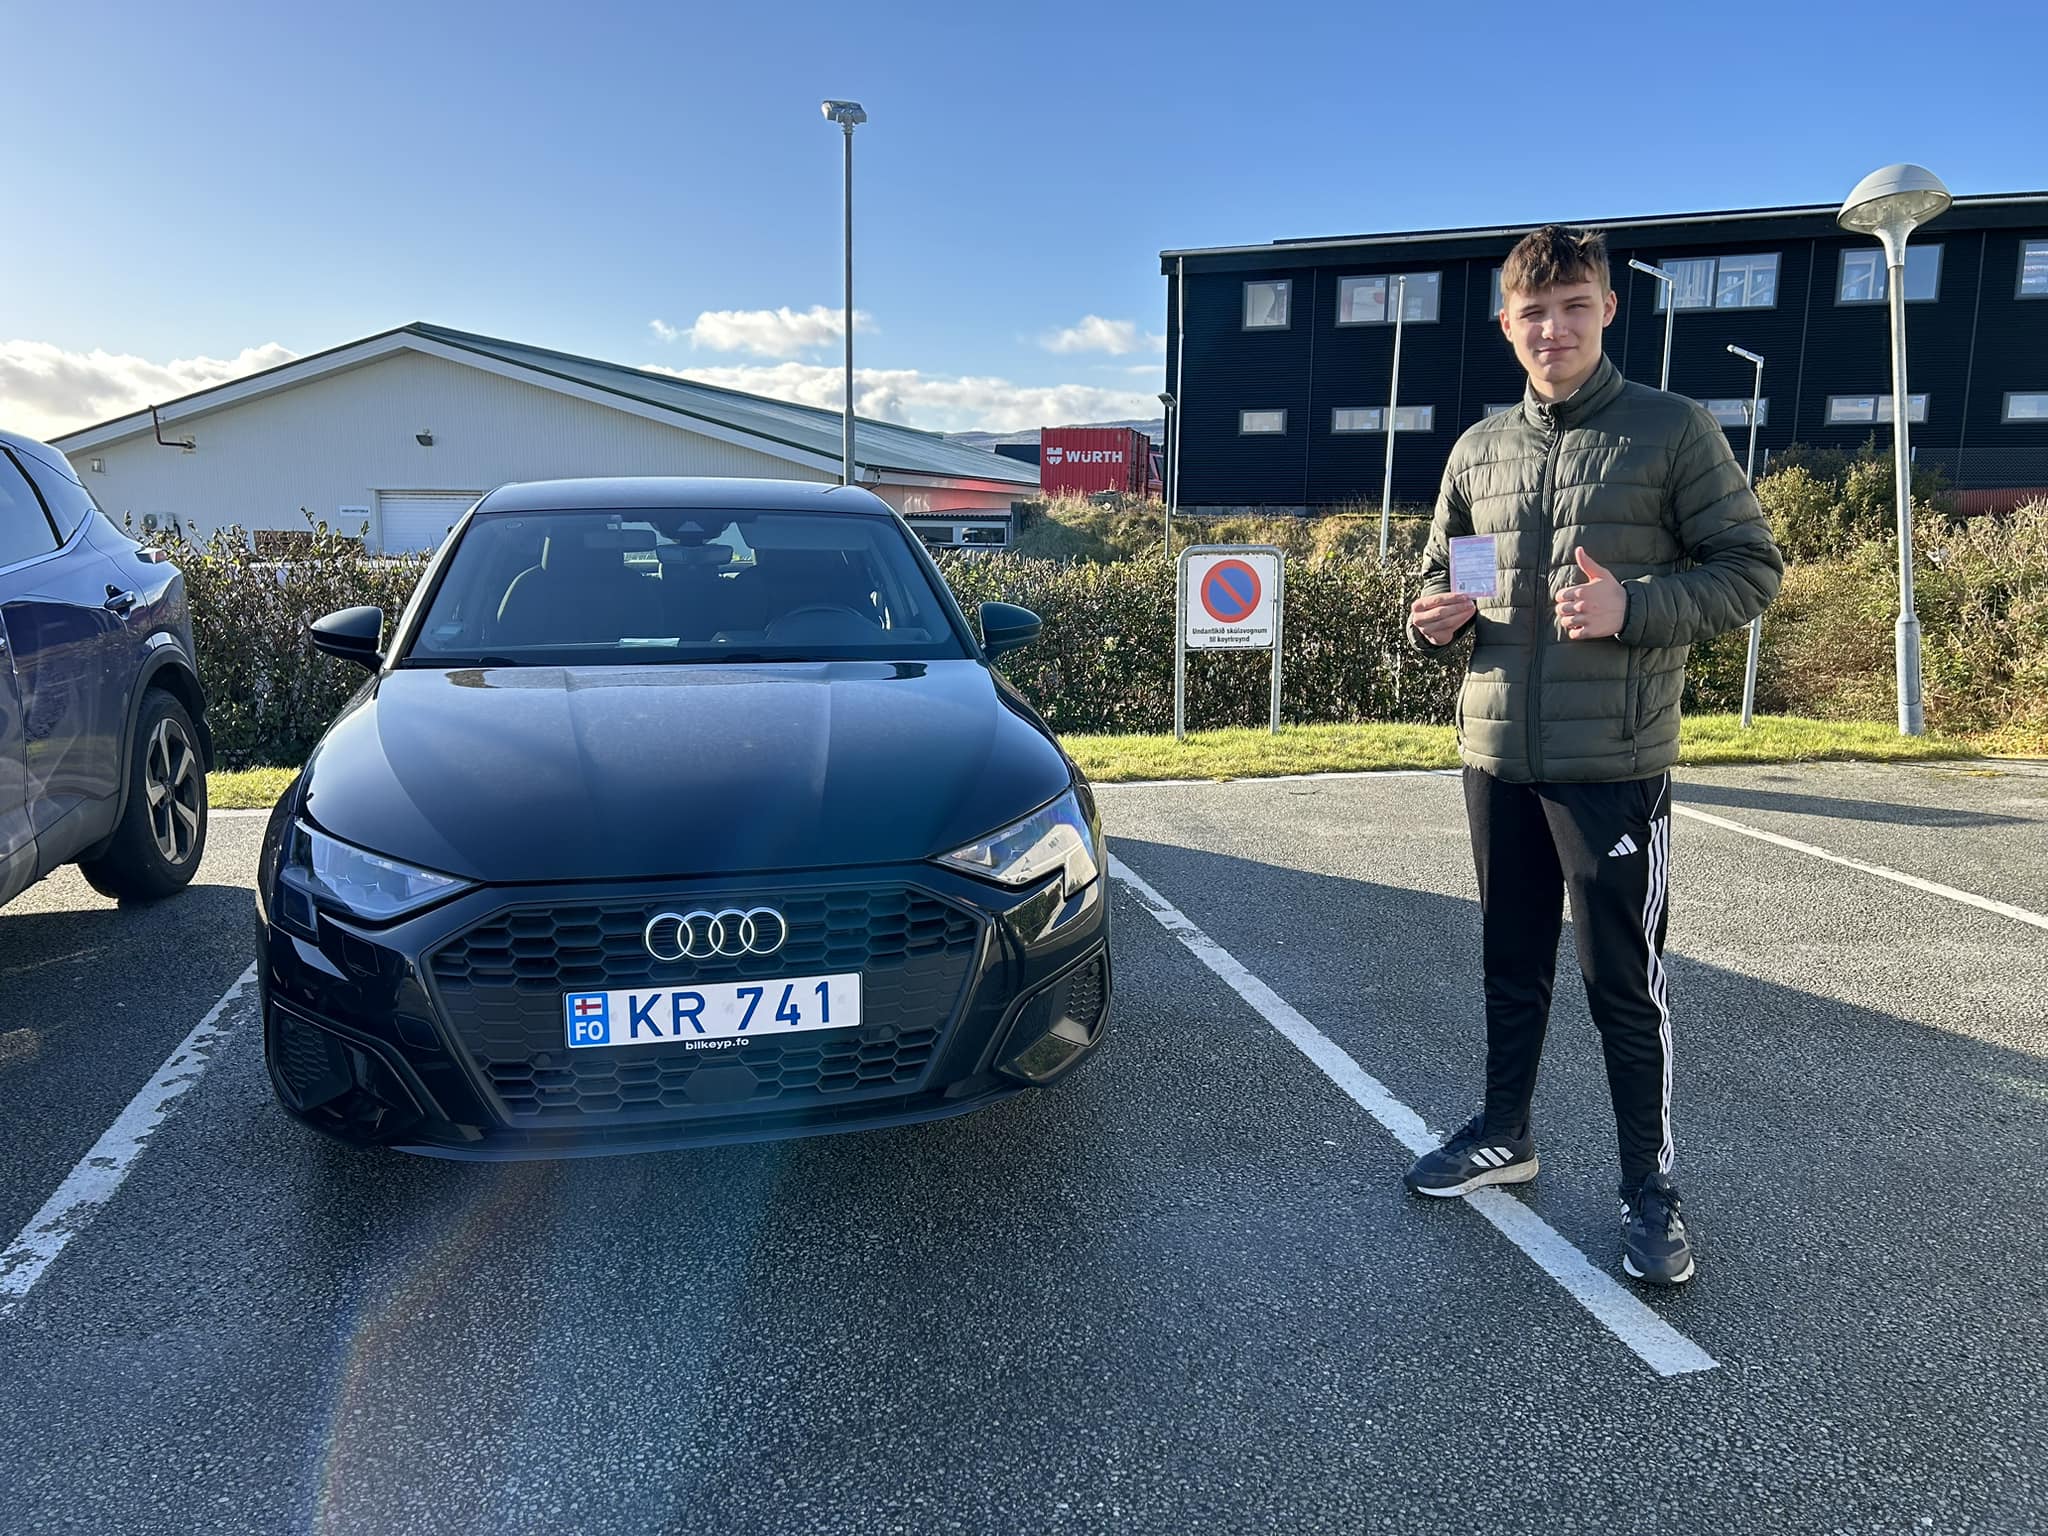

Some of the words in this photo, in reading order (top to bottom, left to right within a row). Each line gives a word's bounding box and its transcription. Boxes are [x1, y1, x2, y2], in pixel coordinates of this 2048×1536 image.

[628, 991, 707, 1039] KR
[736, 981, 830, 1031] 741
[575, 1020, 604, 1041] FO
[685, 1037, 749, 1050] bilkeyp.fo
